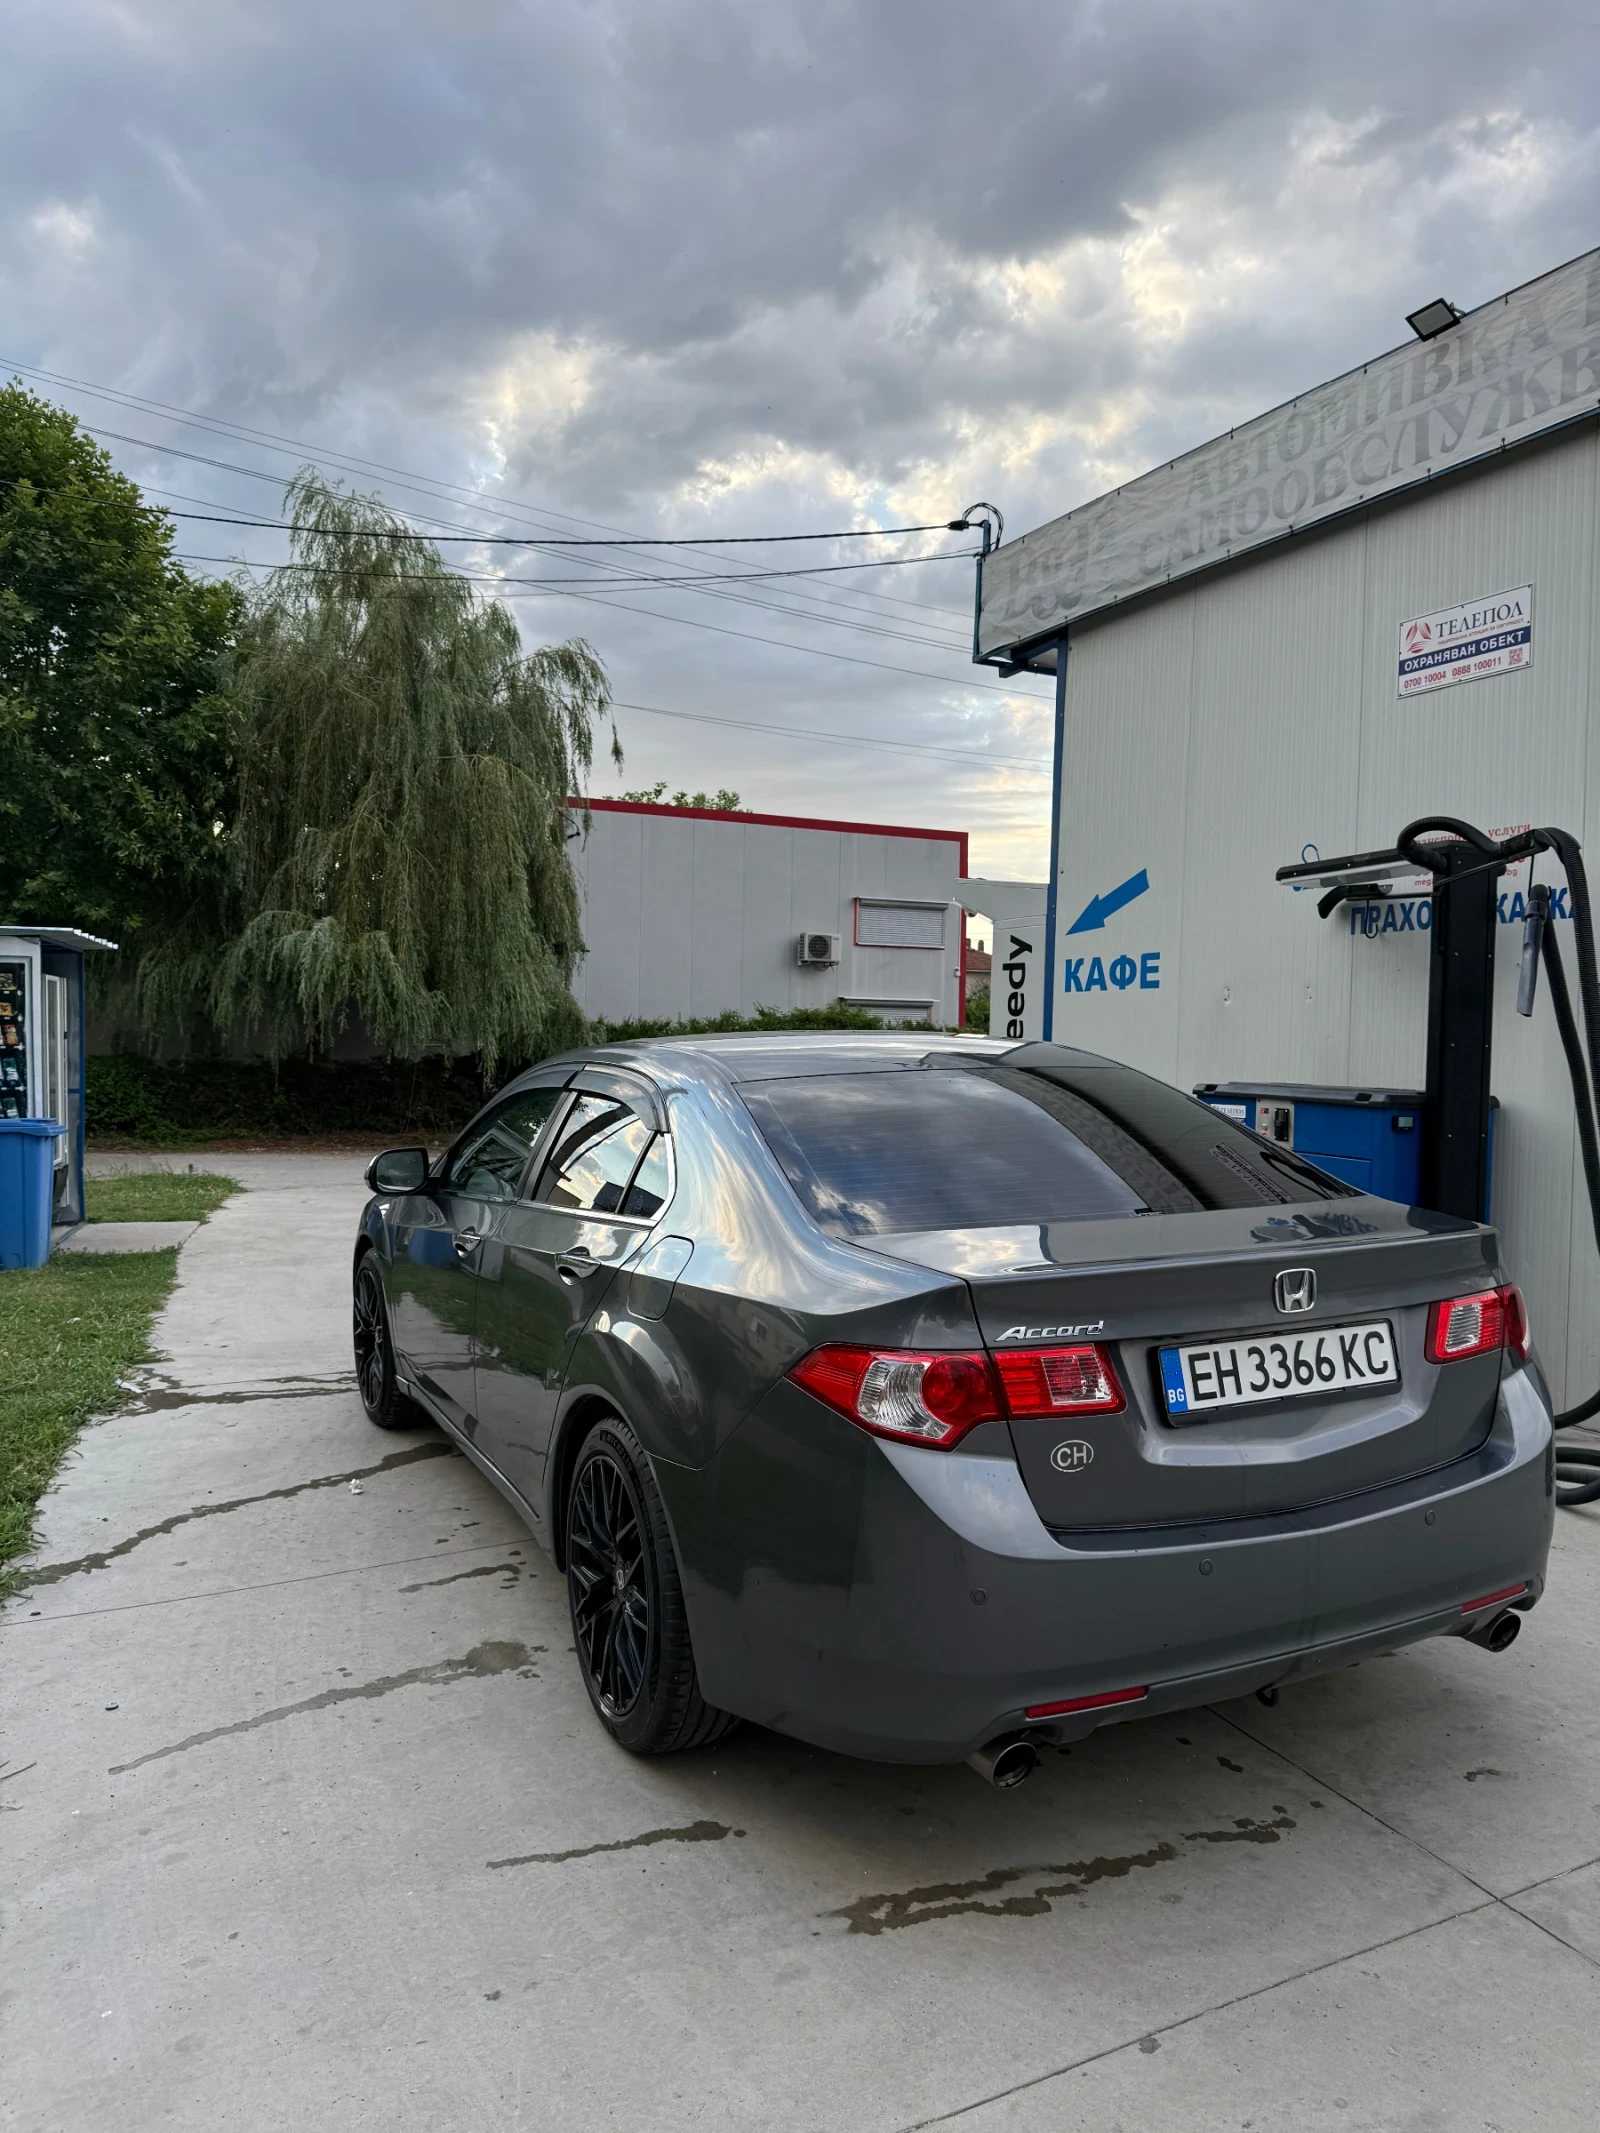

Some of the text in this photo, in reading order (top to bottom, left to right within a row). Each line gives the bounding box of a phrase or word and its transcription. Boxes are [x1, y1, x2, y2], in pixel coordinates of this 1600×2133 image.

[1184, 298, 1550, 507] АВТОМИВКА
[1435, 601, 1524, 638] ТЕЛЕПОЛ
[1437, 634, 1468, 645] НАЦИОНАЛНА
[1496, 618, 1524, 630] СИГУРНОСТ
[1404, 630, 1524, 672] ОХРАНЯВАН ОБЕКТ
[1404, 676, 1422, 689] 0700
[1424, 671, 1446, 684] 10004
[1452, 665, 1471, 677] 0888
[1474, 656, 1502, 672] 100011
[1488, 824, 1531, 838] услуги
[1064, 951, 1161, 993] КАФЕ
[995, 1319, 1104, 1343] Accord
[1247, 1337, 1336, 1393] 3366
[1168, 1388, 1185, 1404] BG
[1057, 1445, 1088, 1468] CH
